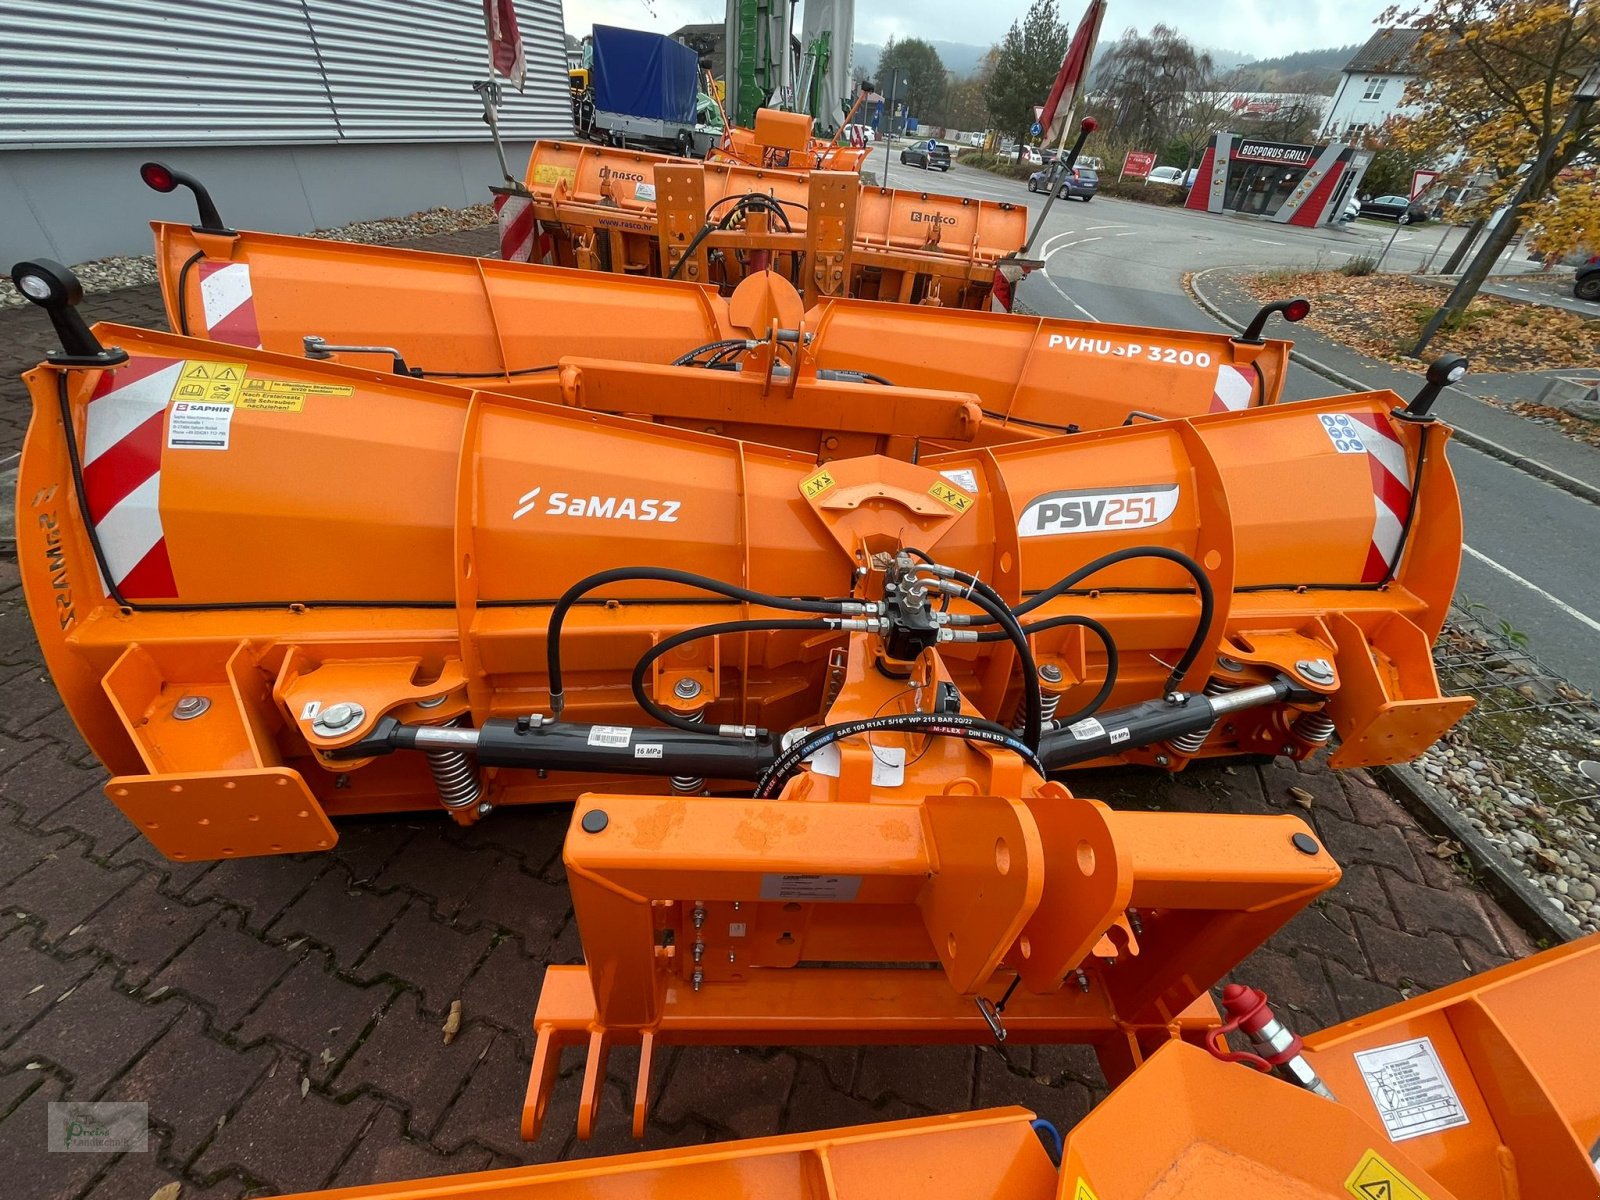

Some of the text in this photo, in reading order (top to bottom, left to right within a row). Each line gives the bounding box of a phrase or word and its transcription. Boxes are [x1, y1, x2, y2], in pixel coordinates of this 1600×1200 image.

[1242, 145, 1306, 160] BOSPORUS GRILL
[599, 218, 652, 231] www.rasco.hr
[1147, 346, 1211, 368] 3200
[545, 492, 681, 522] SaMASZ
[1036, 496, 1158, 530] PSV251
[837, 728, 852, 737] SAE
[853, 724, 865, 732] 100
[866, 720, 886, 728] R1AT
[933, 726, 961, 734] M-FLEX
[993, 733, 1004, 742] 853
